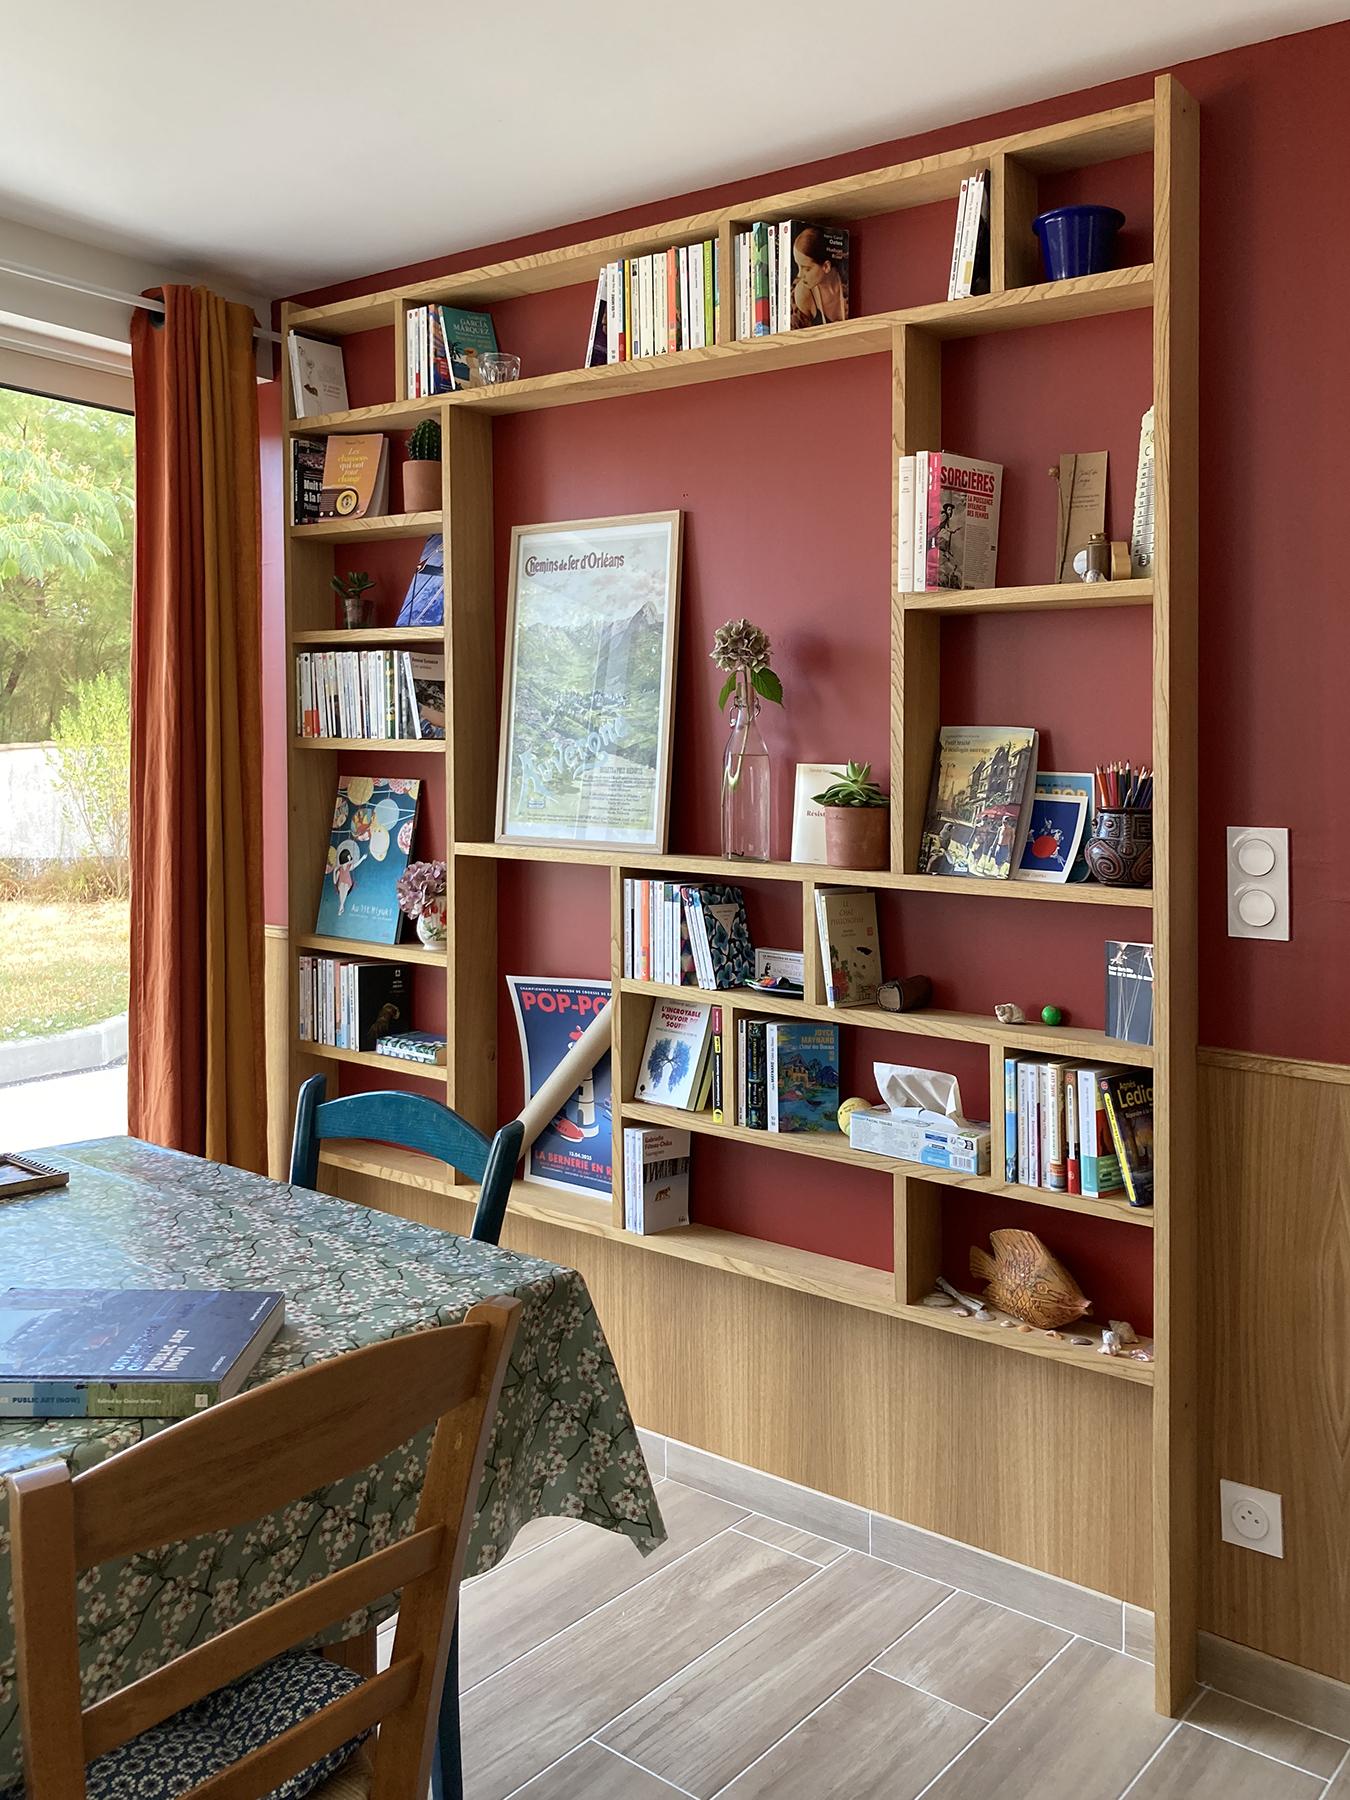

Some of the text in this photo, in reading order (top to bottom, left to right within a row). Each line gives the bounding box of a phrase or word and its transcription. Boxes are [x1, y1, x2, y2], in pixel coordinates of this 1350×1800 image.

[304, 479, 318, 491] Nuit
[940, 466, 995, 493] SORCIÈRES
[525, 552, 625, 577] Chemins de fer d'Orléans
[661, 1006, 701, 1018] L'INCROYABLE
[661, 1013, 688, 1022] POUVOIR
[535, 1150, 546, 1159] LA
[548, 1152, 589, 1170] BERNERIE
[592, 1163, 603, 1173] EN
[143, 1338, 178, 1372] PUBLIC
[169, 1329, 190, 1343] ART
